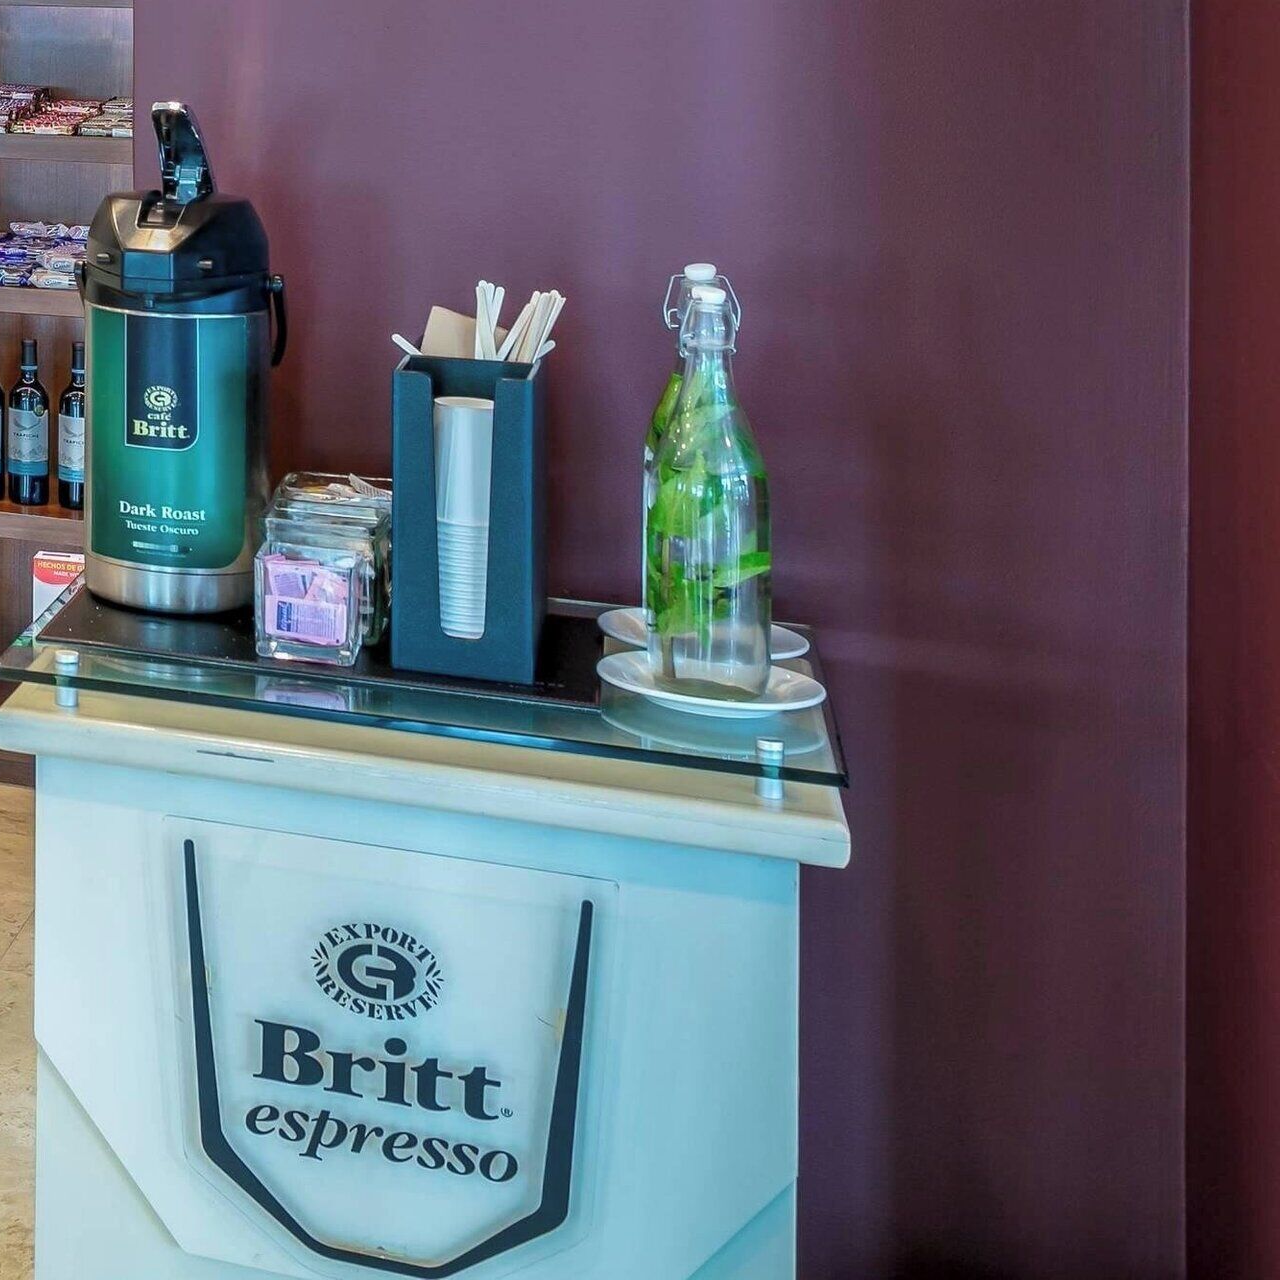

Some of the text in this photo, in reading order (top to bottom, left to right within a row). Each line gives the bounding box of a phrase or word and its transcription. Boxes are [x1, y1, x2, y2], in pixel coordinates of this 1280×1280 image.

[147, 411, 172, 421] café
[132, 419, 190, 439] Britt
[119, 500, 206, 521] Dark Roast
[160, 525, 199, 536] Oscuro
[37, 561, 66, 570] HECHOS
[324, 923, 435, 963] EXPORT
[320, 973, 438, 1020] RESERVE
[252, 1019, 502, 1121] Britt
[245, 1104, 519, 1183] espresso
